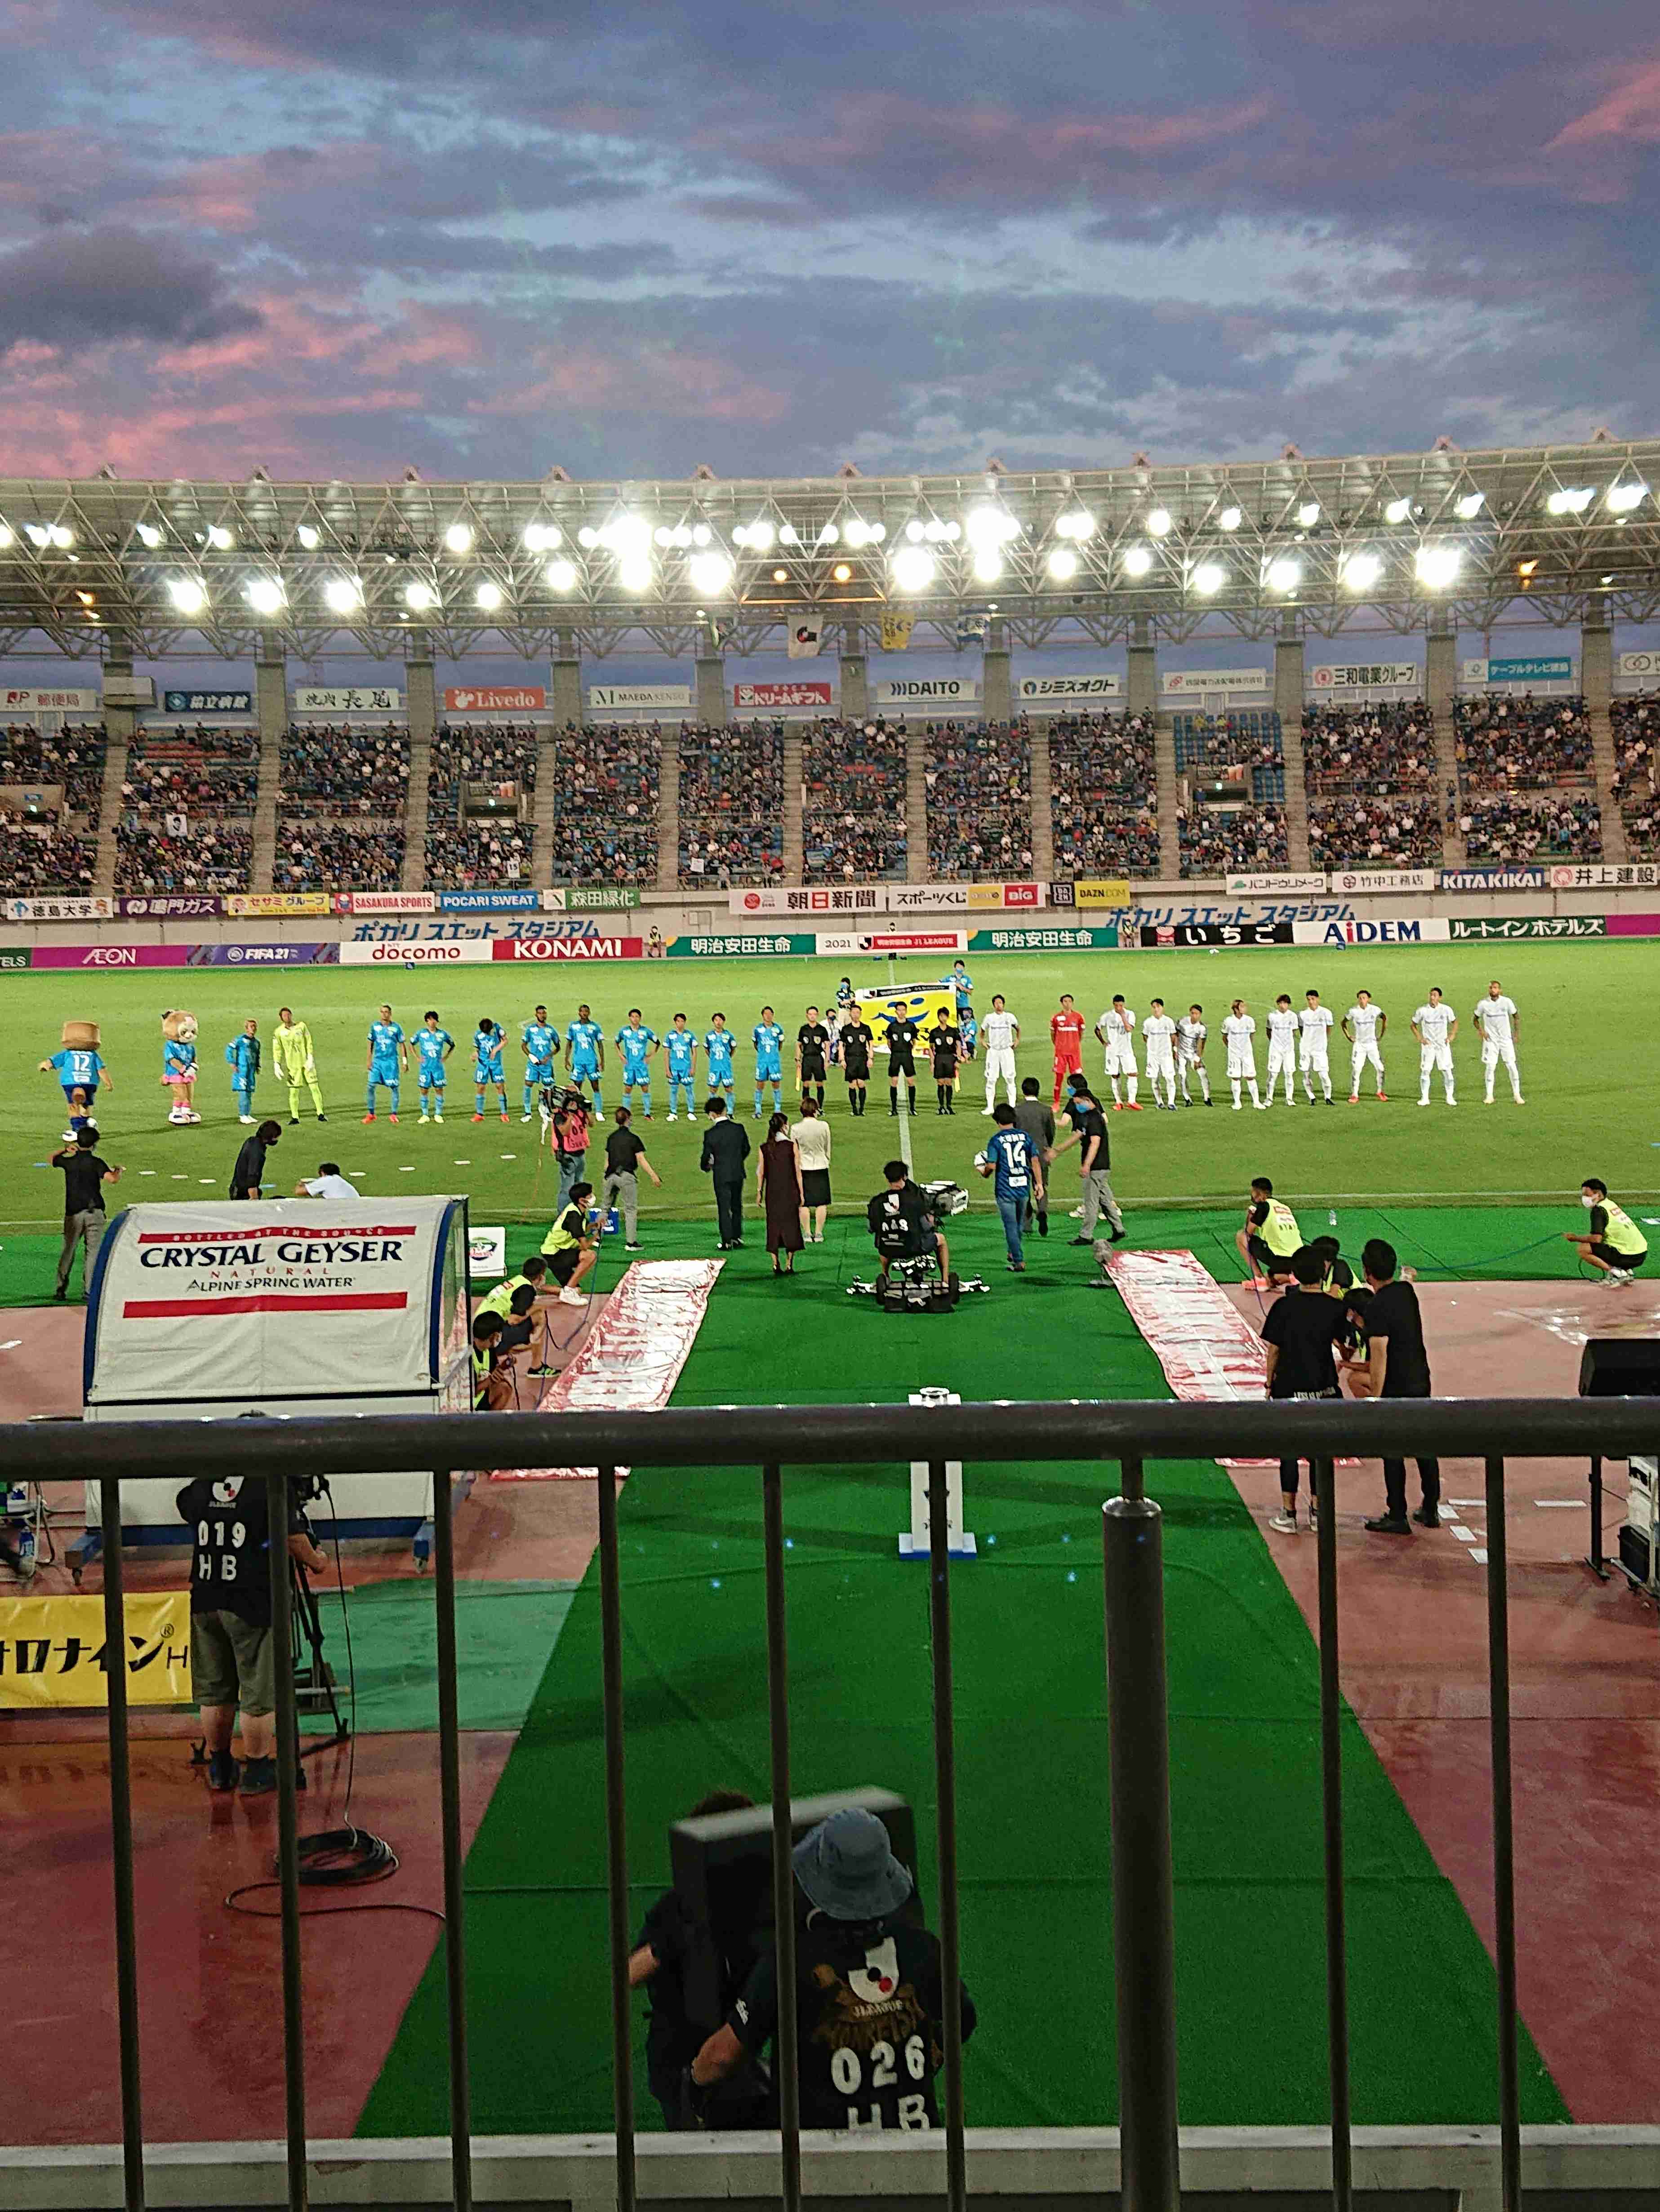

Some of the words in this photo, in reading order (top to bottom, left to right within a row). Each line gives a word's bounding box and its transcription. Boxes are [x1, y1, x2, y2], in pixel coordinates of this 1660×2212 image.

[908, 681, 960, 695] DAITO
[476, 691, 536, 707] Livedo
[619, 693, 654, 702] MAEDA
[1576, 867, 1655, 884] 井上建設
[355, 897, 399, 909] SASAKURA
[401, 896, 432, 908] SPORTS
[443, 894, 490, 907] POCARI
[491, 894, 535, 906] SWEAT
[787, 889, 876, 910] 朝日新聞
[897, 890, 966, 905] スポーツくじ
[31, 905, 92, 917] 徳島大学
[149, 898, 215, 914] 鳴門ガス
[991, 929, 1093, 948] 明治安田生命
[1185, 924, 1277, 945] いちご
[514, 938, 622, 958] KONAMI
[690, 936, 792, 954] 明治安田生命
[824, 939, 851, 948] 2021
[372, 944, 461, 960] docomo
[0, 956, 26, 967] ELS
[73, 1054, 90, 1071] 12
[1003, 1141, 1027, 1168] 14
[172, 1233, 245, 1242] BOTTLED
[282, 1228, 311, 1237] THE
[140, 1243, 266, 1268] CRYSTAL
[277, 1240, 402, 1264] GEYSER
[211, 1267, 329, 1279] NATURAL
[186, 1279, 242, 1292] ALPINE
[245, 1277, 299, 1289] SPRING
[303, 1277, 353, 1288] WATER
[198, 1519, 246, 1549] 019
[831, 2034, 926, 2095] 026
